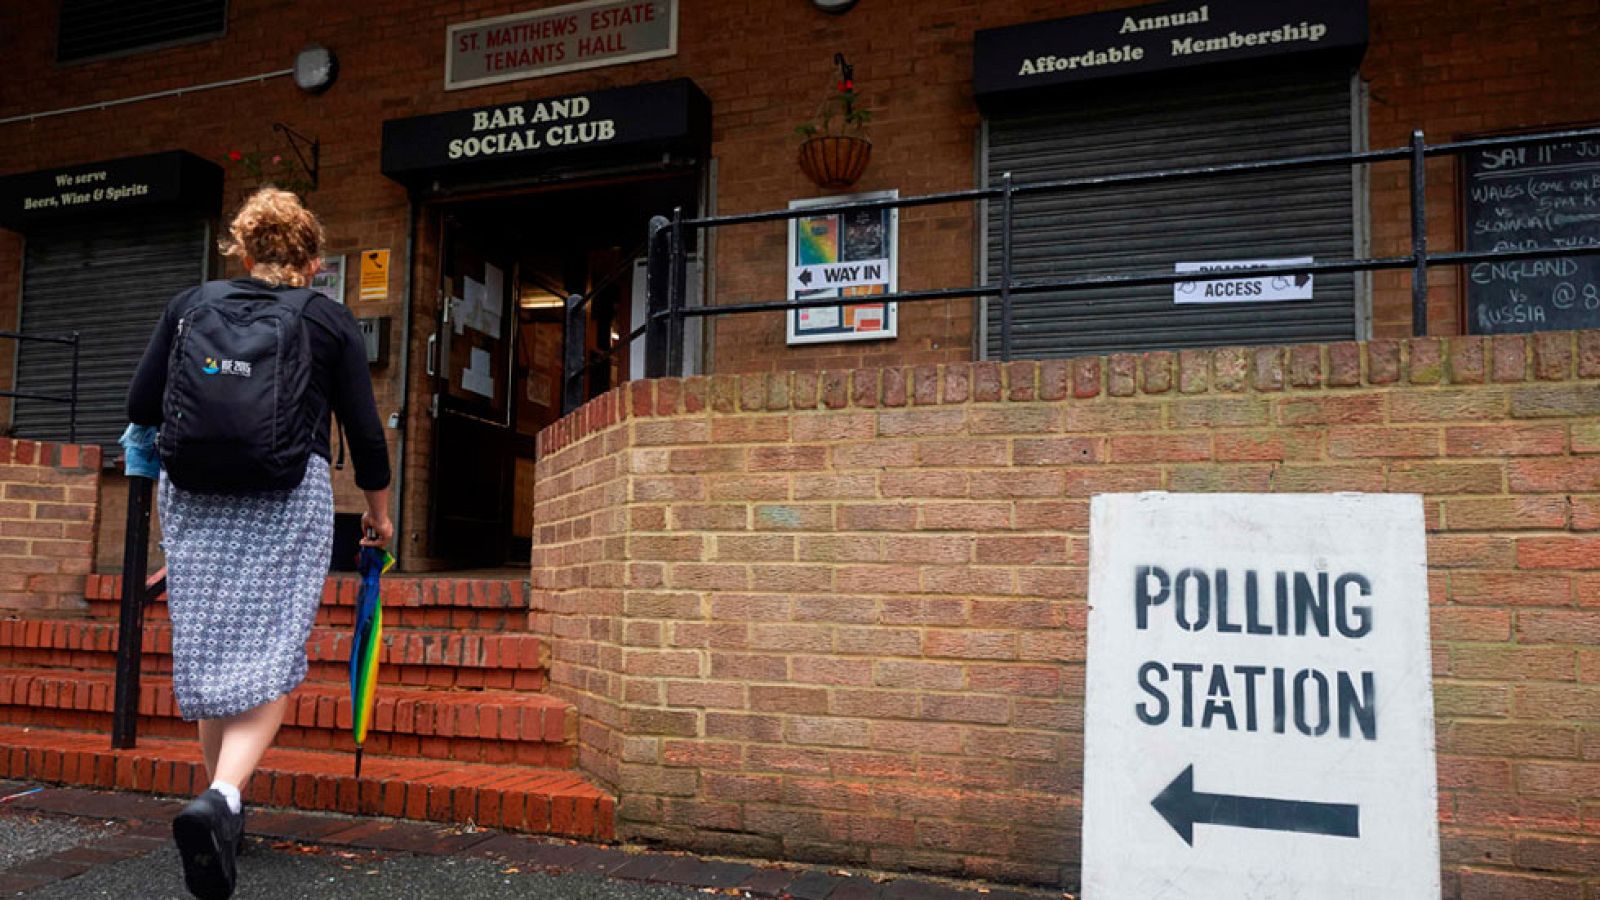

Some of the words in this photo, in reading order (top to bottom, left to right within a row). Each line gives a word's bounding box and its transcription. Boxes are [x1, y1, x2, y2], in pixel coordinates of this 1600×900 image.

[459, 33, 480, 52] ST.
[486, 16, 577, 48] MATTHEWS
[590, 3, 655, 32] ESTATE
[1119, 5, 1210, 34] Annual
[485, 42, 565, 73] TENANTS
[578, 32, 627, 58] HALL
[1018, 45, 1144, 76] Affordable
[1171, 22, 1327, 57] Membership
[472, 106, 526, 132] BAR
[531, 96, 591, 123] AND
[448, 130, 540, 159] SOCIAL
[546, 119, 616, 147] CLUB
[55, 175, 73, 187] We
[75, 171, 107, 184] serve
[24, 196, 59, 210] Beers,
[62, 193, 91, 206] Wine
[93, 188, 104, 201] &
[105, 184, 149, 201] Spirits
[1471, 185, 1525, 204] WALES
[824, 266, 860, 283] WAY
[863, 264, 881, 280] IN
[1471, 258, 1578, 284] ENGLAND
[1204, 280, 1263, 297] ACCESS
[1478, 304, 1546, 328] RUSSIA
[1135, 565, 1373, 640] POLLING
[1135, 660, 1377, 742] STATION
